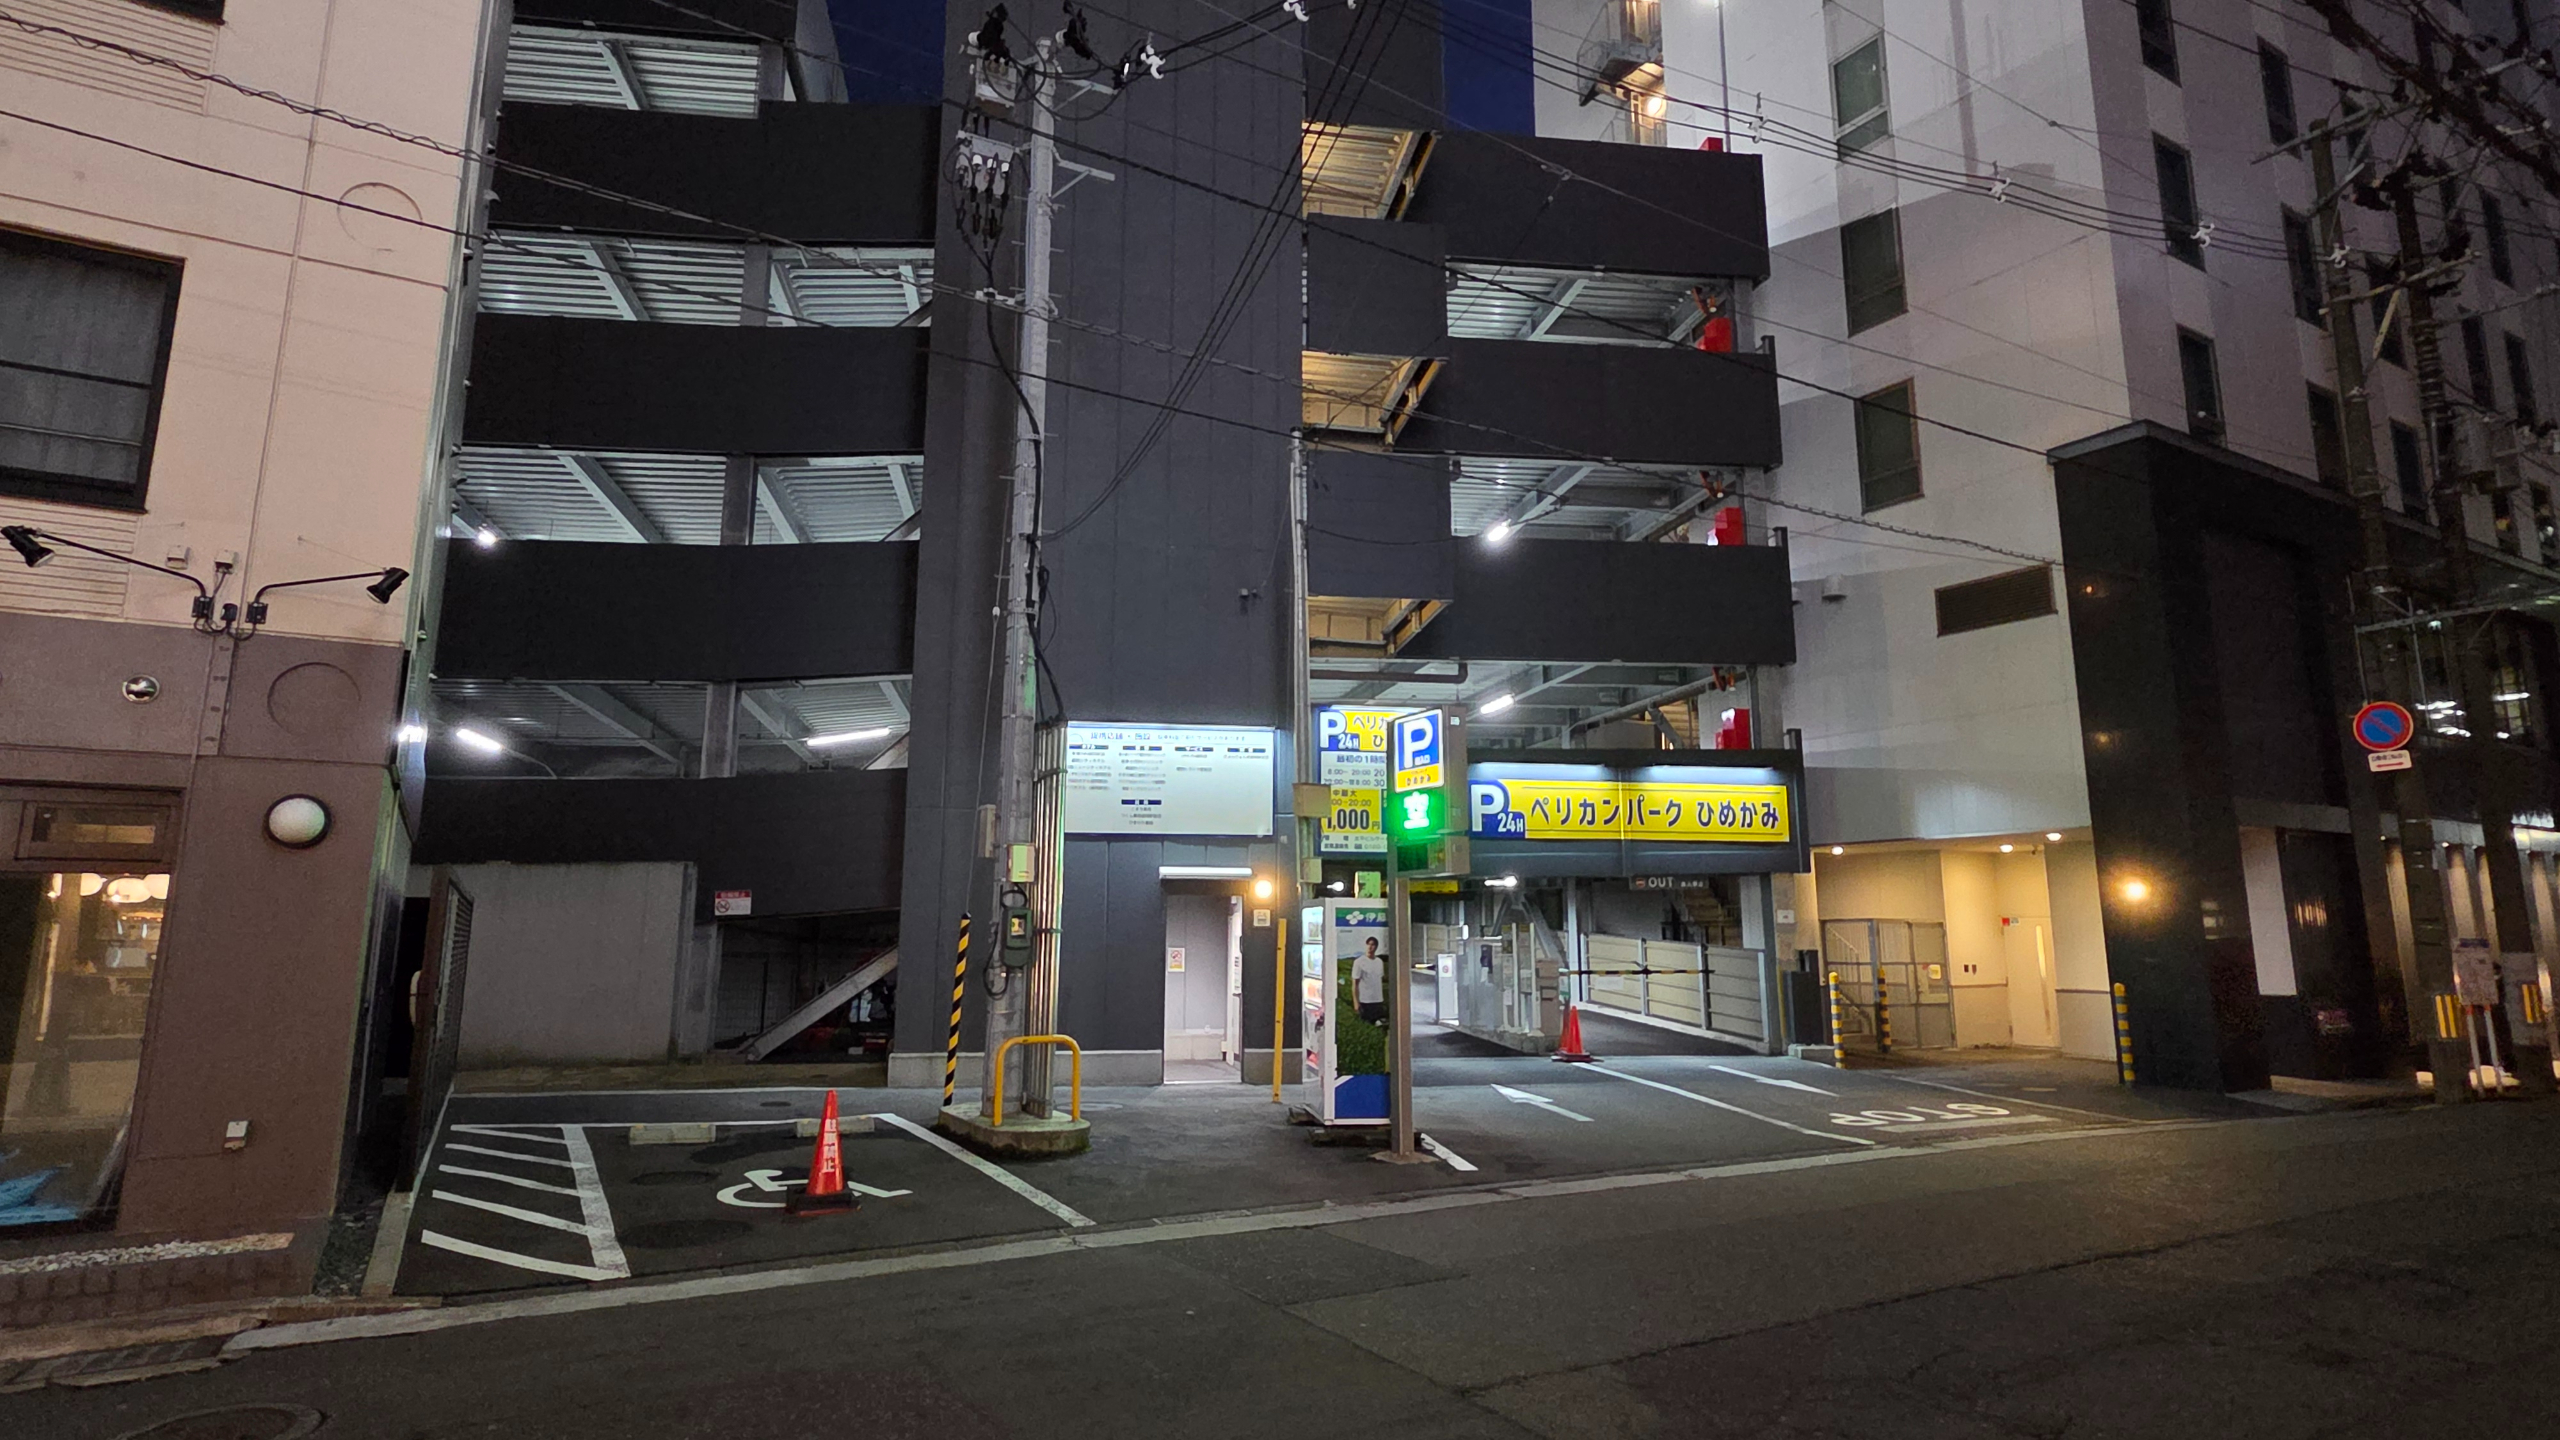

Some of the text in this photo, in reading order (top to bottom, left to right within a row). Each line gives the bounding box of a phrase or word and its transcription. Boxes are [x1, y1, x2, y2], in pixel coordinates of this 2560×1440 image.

[1320, 711, 1347, 748] P
[1404, 716, 1433, 768] P
[1470, 784, 1505, 832] P
[1497, 812, 1524, 833] 24H
[1531, 793, 1780, 829] ペリカンパーク ひめかみ
[1648, 876, 1673, 888] OUT
[1829, 1103, 2010, 1126] STOP
